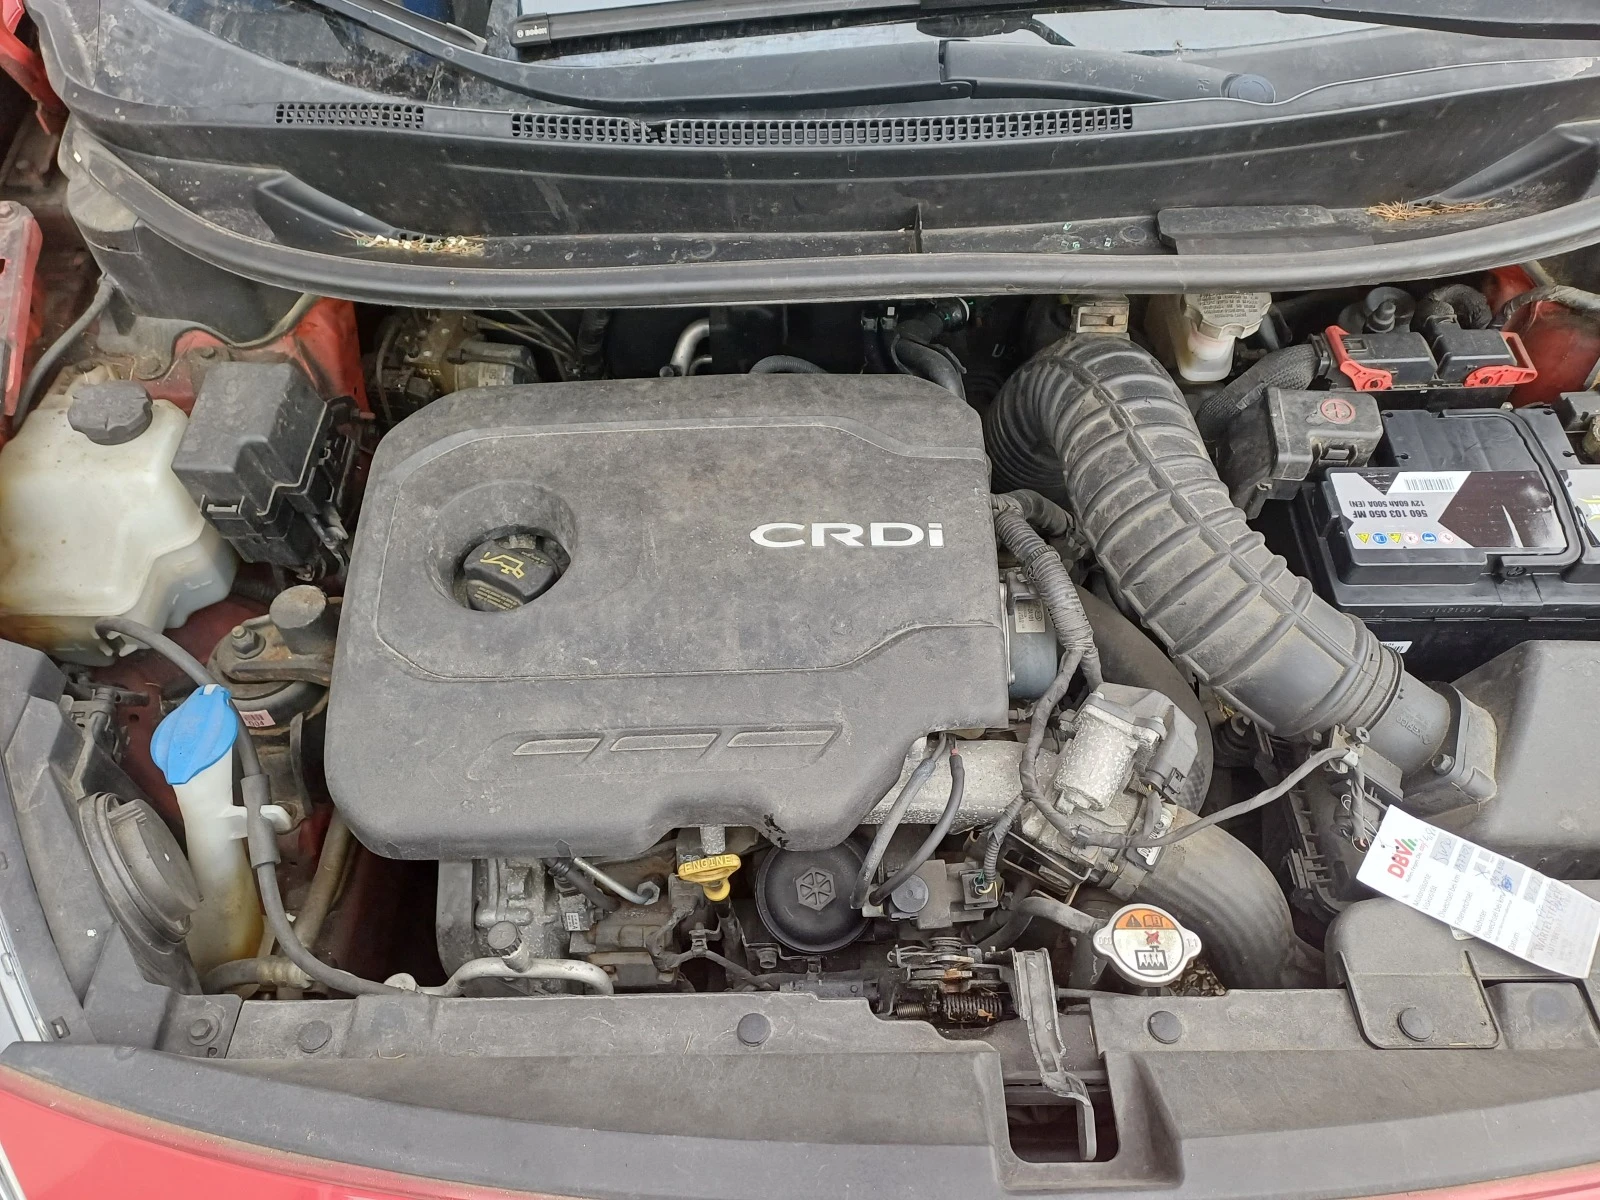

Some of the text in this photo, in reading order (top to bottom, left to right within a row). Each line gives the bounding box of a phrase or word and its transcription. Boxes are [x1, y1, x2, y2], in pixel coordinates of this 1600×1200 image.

[1353, 510, 1428, 518] 560 103 050 MF
[749, 522, 944, 548] CRDi
[684, 854, 732, 872] ENGINE
[1387, 838, 1415, 879] DBV
[1508, 930, 1521, 951] Datum
